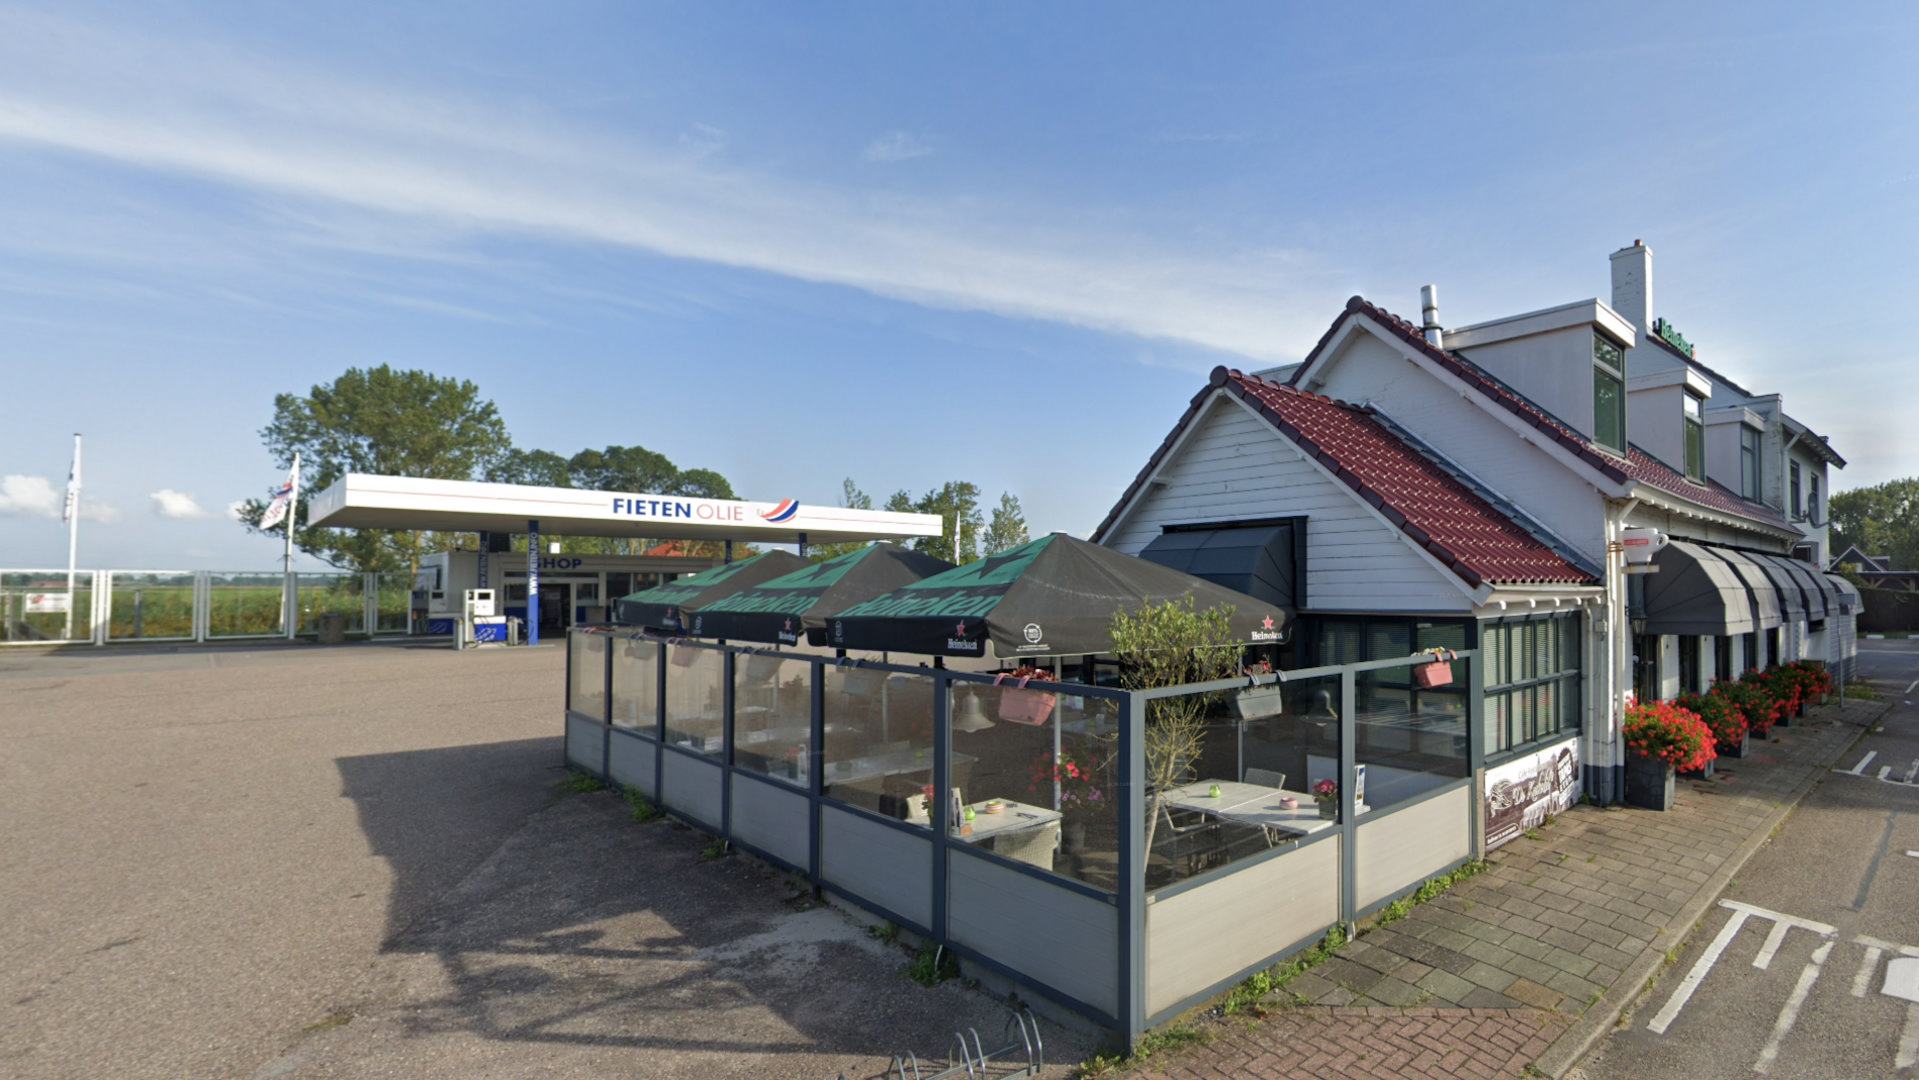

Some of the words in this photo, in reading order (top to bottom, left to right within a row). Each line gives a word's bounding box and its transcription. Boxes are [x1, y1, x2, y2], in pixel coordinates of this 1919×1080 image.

[613, 498, 691, 518] FIETEN
[697, 504, 743, 521] OLIE
[538, 558, 582, 569] HOP
[833, 590, 1004, 618] Heineken
[948, 638, 978, 650] Heineken
